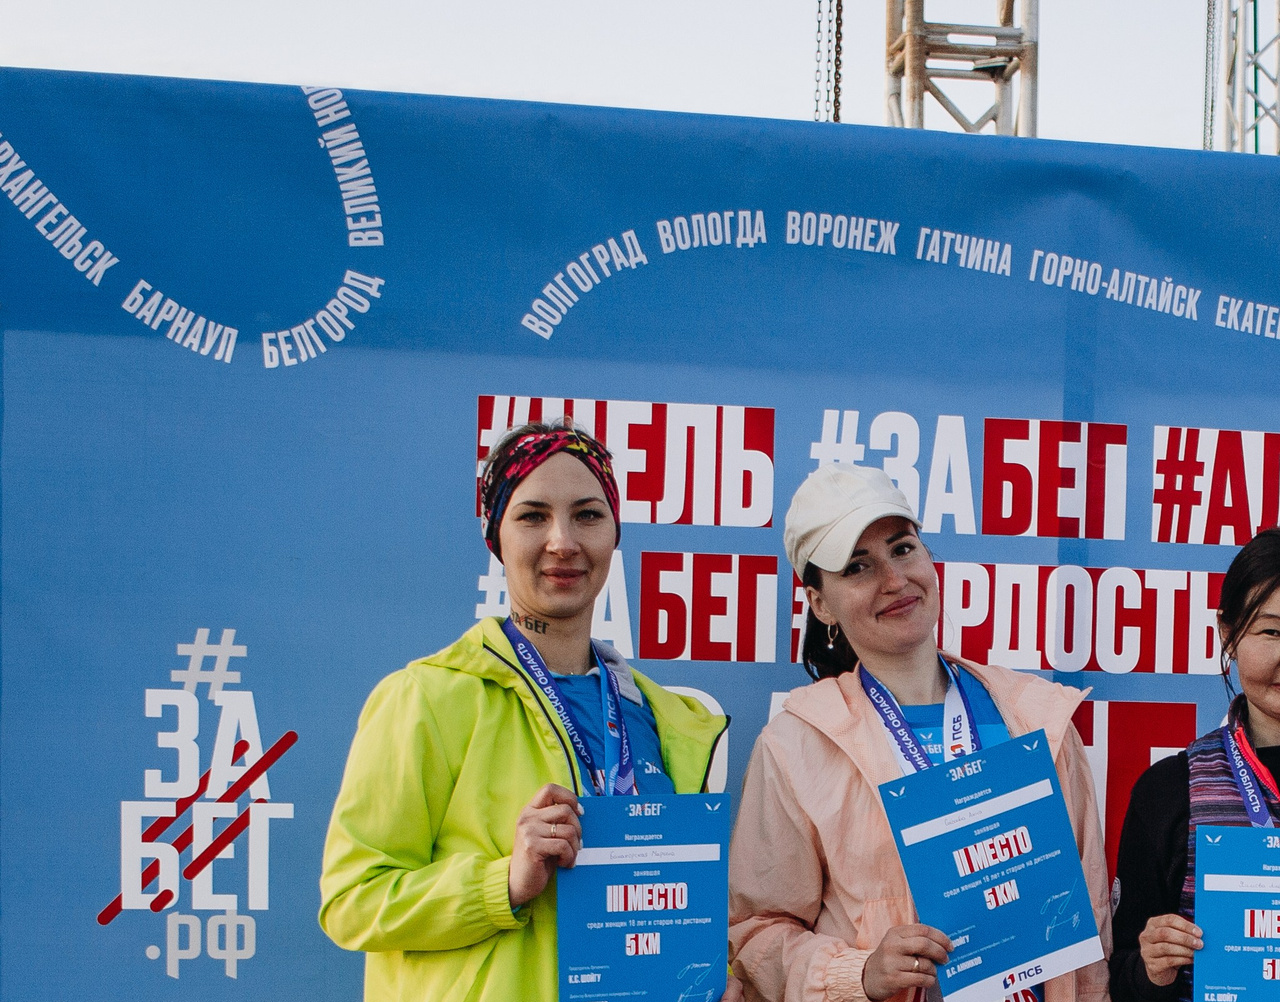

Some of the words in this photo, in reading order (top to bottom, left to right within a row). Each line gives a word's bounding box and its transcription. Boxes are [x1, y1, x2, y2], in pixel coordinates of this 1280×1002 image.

[318, 123, 384, 247] ВЕЛИКИЙ
[0, 132, 119, 286] РХАНГЕЛЬСК
[521, 229, 648, 340] ВОЛГОГРАД
[657, 211, 767, 254] ВОЛОГДА
[786, 211, 900, 255] ВОРОНЕЖ
[916, 227, 1012, 277] ГАТЧИНА
[1029, 249, 1201, 321] ГОРНО-АЛТАЙСК
[122, 279, 238, 363] БАРНАУЛ
[262, 269, 385, 368] БЕЛГОРОД
[170, 628, 247, 700] #
[517, 642, 548, 685] ОБЛАСТЬ
[543, 686, 591, 764] САХАЛИНСКАЯ
[869, 687, 901, 728] ОБЛАСТЬ
[952, 713, 962, 741] ПСБ
[145, 689, 271, 799] ЗА
[954, 788, 992, 806] Награждается
[1239, 769, 1260, 813] ОБЛАСТЬ
[625, 833, 662, 841] Награждается
[969, 825, 1033, 873] МЕСТО
[973, 822, 1000, 836] занявшая
[121, 801, 294, 910] БЕГ
[943, 888, 960, 898] среди
[960, 880, 982, 892] женщин
[990, 872, 1000, 881] лет
[1005, 863, 1026, 876] старше
[1034, 850, 1061, 866] дистанции
[628, 882, 688, 911] МЕСТО
[983, 889, 996, 910] 5
[995, 879, 1020, 906] КМ
[587, 921, 603, 929] среди
[653, 919, 673, 927] старше
[683, 918, 711, 926] дистанции
[625, 933, 636, 956] 5
[638, 932, 661, 955] КМ
[1018, 965, 1043, 981] ПСБ
[1263, 958, 1273, 980] 5
